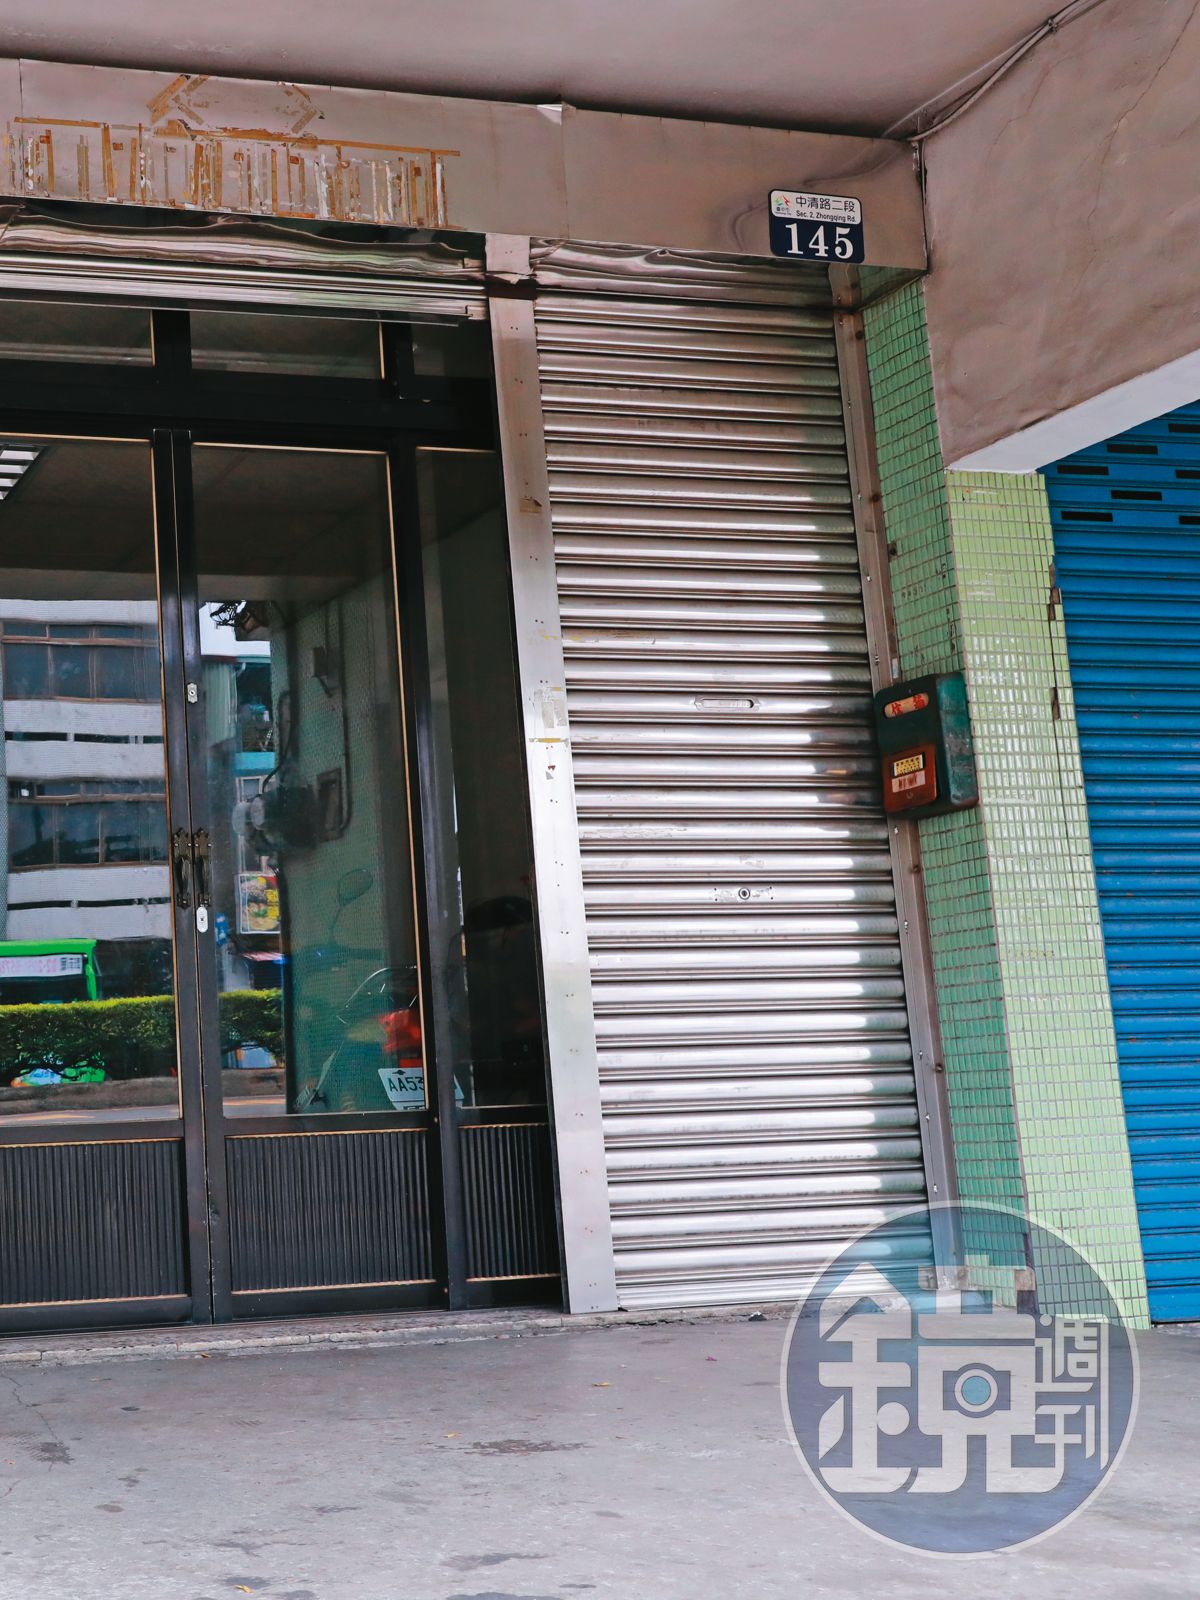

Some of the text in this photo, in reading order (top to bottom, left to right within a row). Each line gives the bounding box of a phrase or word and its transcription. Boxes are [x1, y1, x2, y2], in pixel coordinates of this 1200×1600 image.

[796, 196, 855, 212] 中清路二段
[816, 212, 846, 222] Zhongqing
[785, 223, 854, 259] 145
